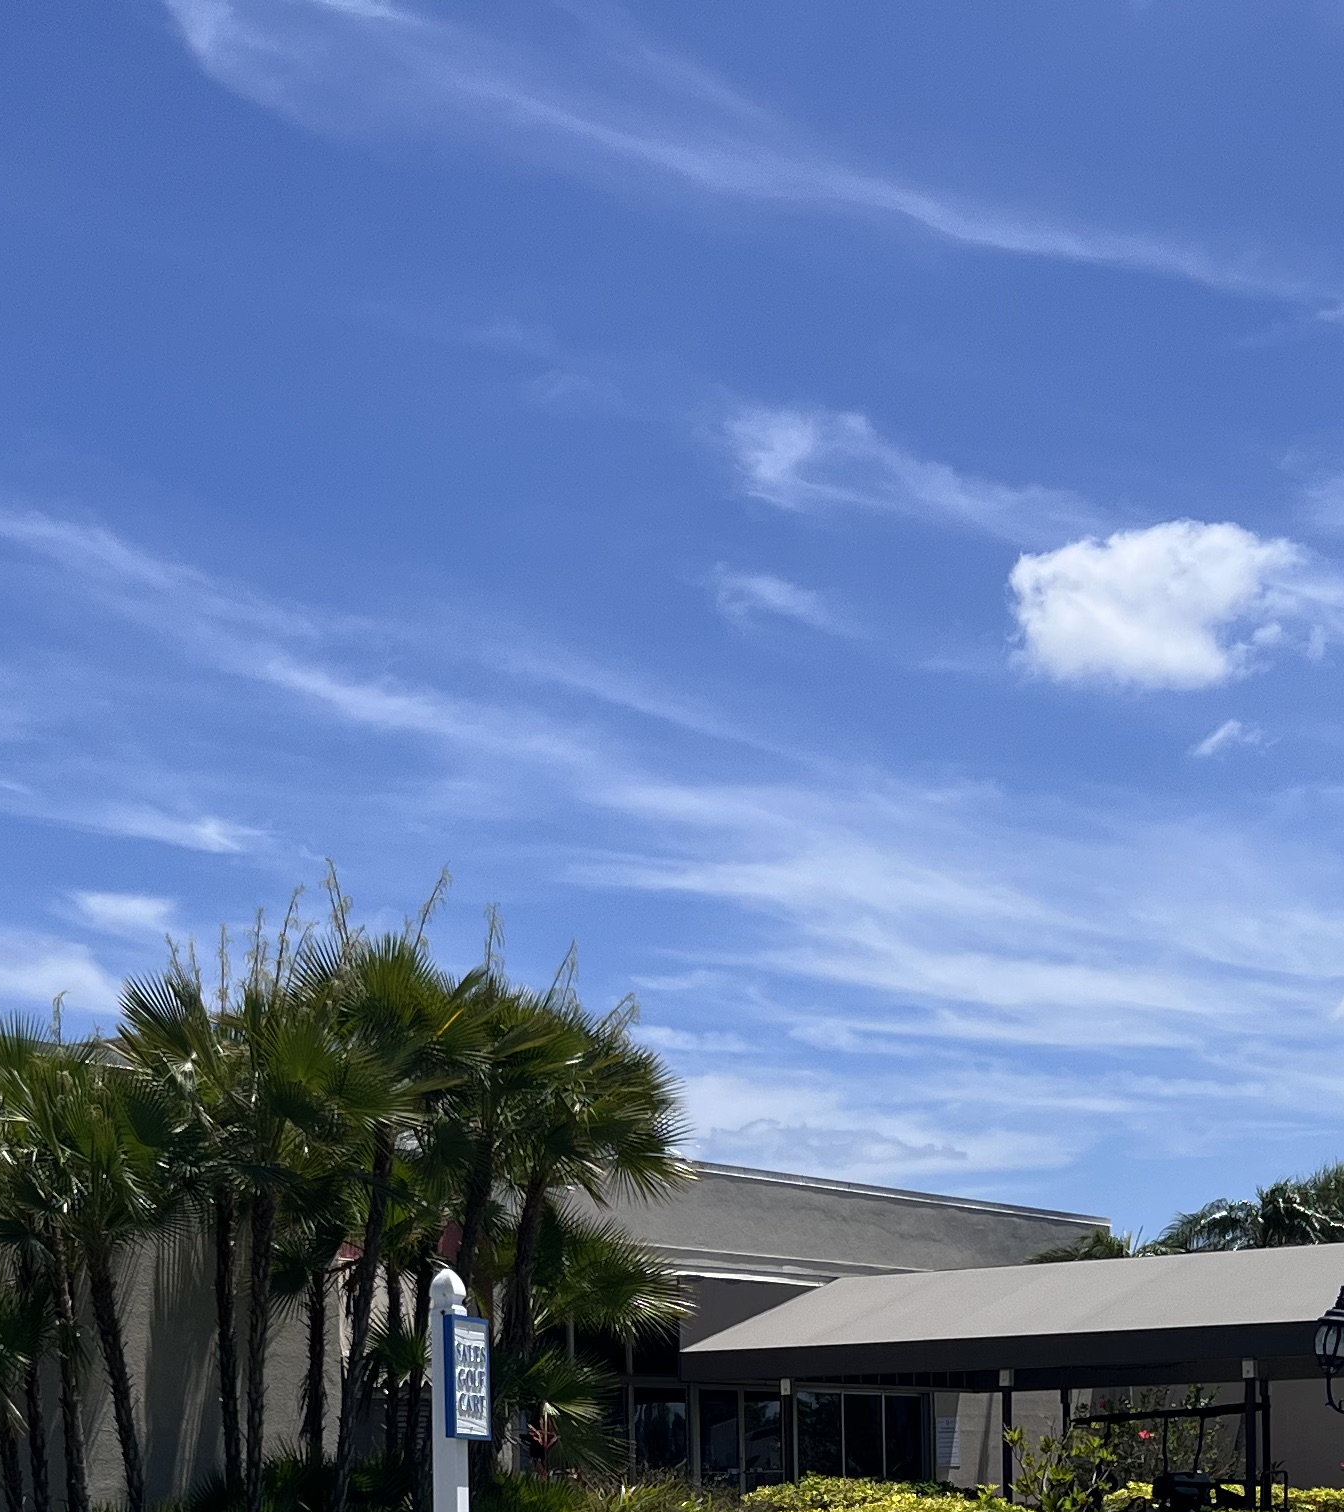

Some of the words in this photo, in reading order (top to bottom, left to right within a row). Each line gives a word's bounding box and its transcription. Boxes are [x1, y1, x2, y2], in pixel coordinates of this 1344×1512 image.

[456, 1343, 486, 1363] SALES
[458, 1369, 485, 1388] GOLF
[459, 1393, 485, 1414] CART
